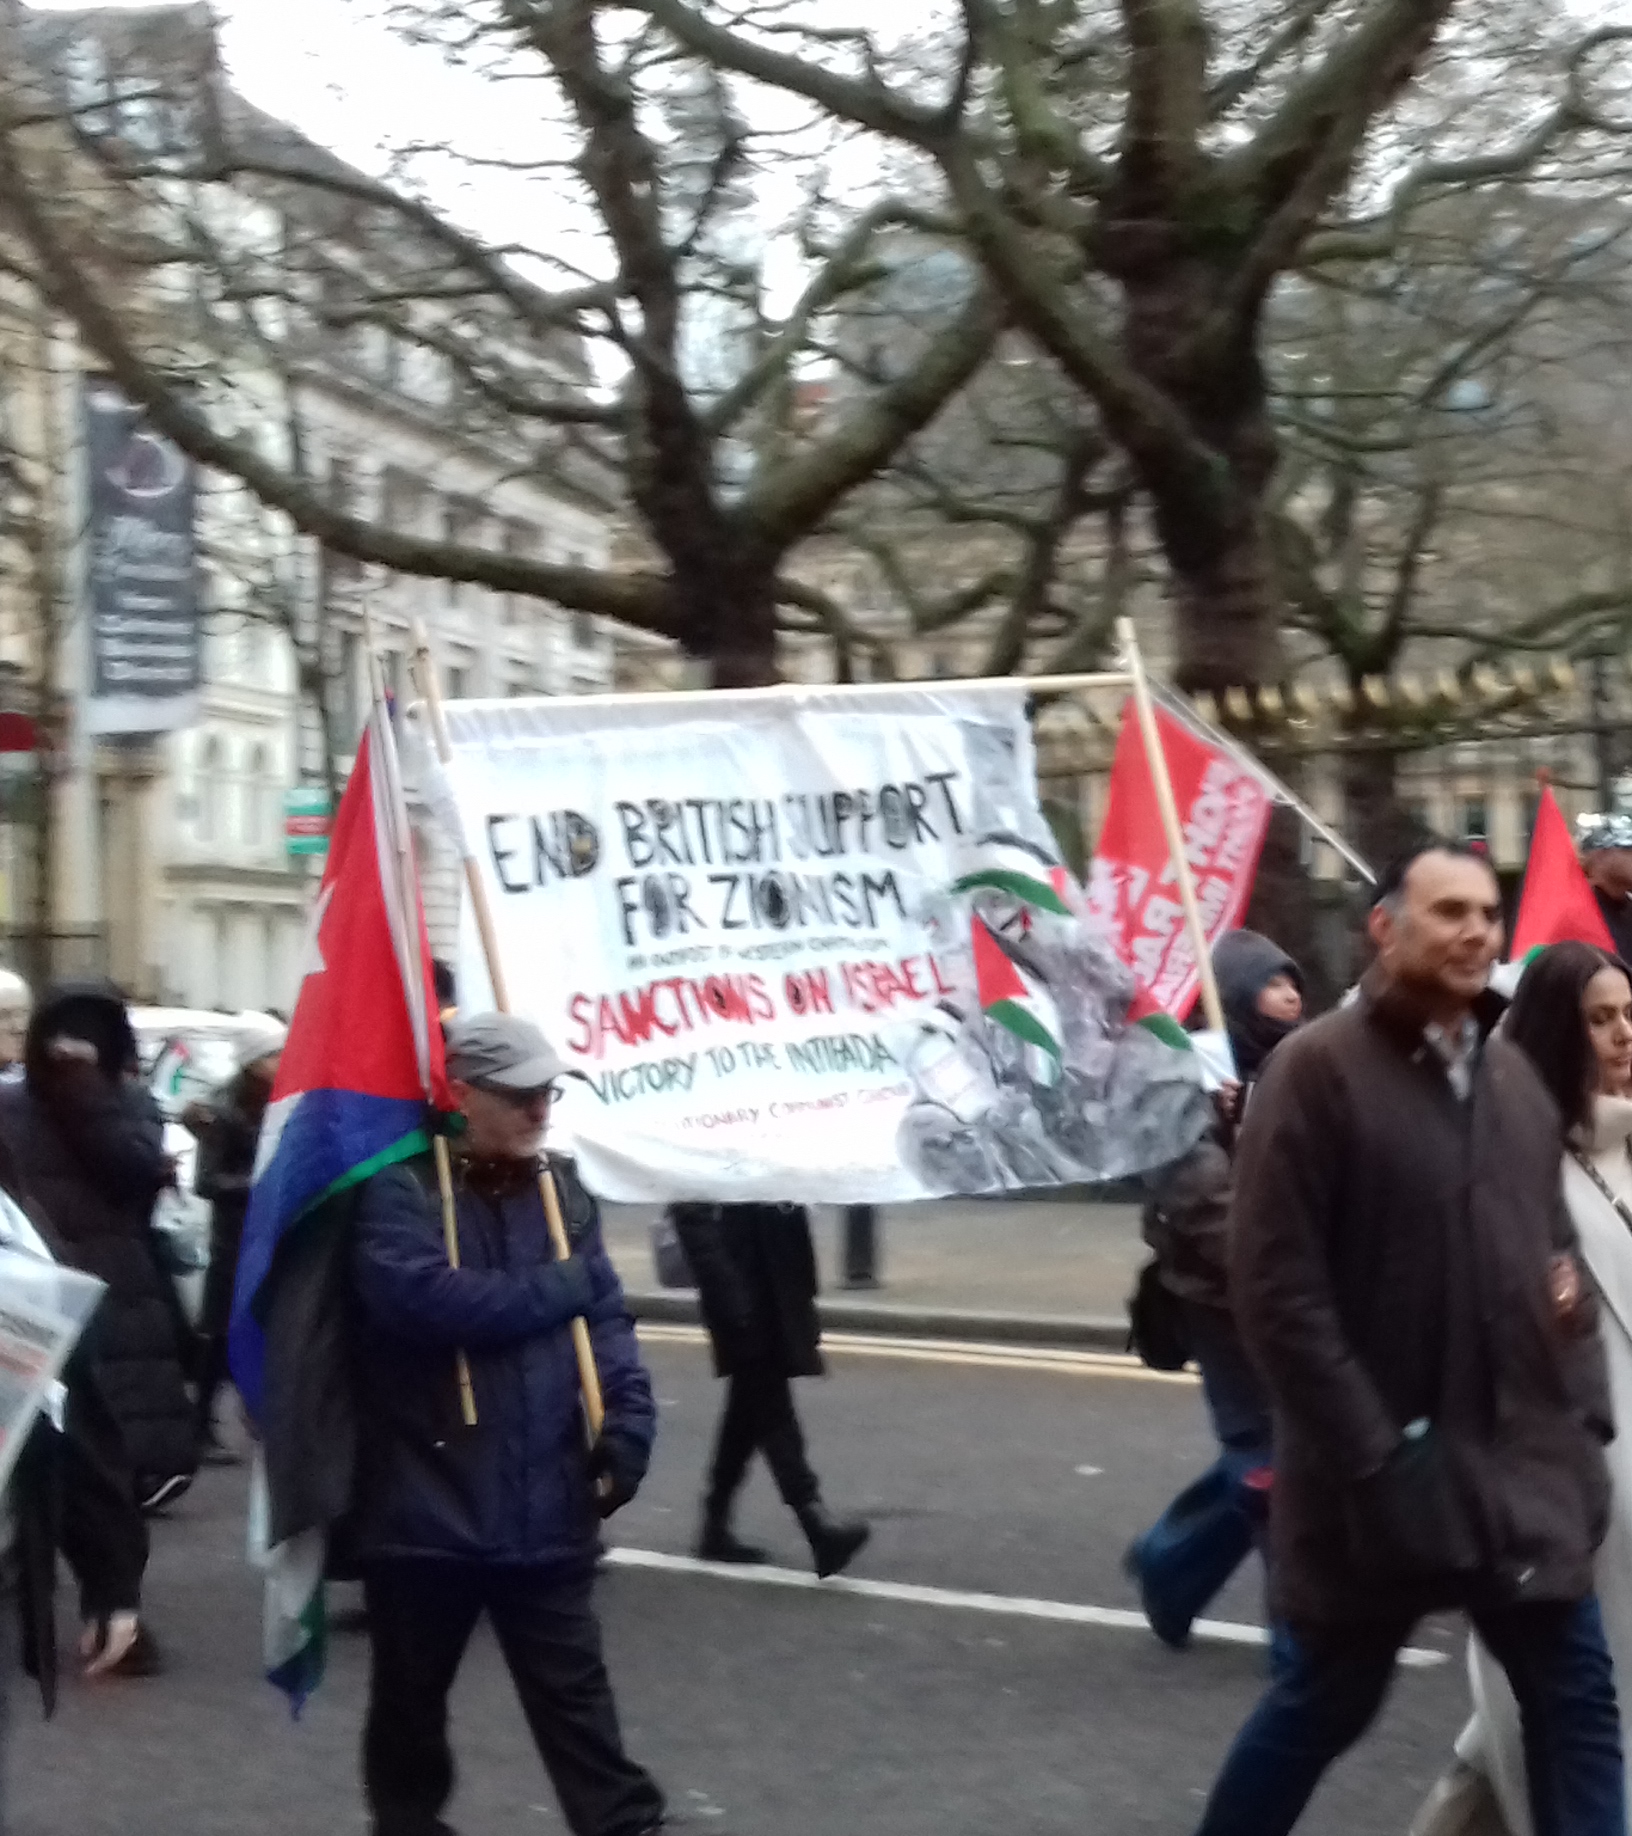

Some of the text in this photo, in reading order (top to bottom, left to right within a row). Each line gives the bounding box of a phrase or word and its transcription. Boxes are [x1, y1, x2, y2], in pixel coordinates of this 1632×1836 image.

[485, 771, 964, 894] END BRITISH SUPPORT
[615, 868, 907, 946] FOR ZIONISM
[566, 951, 958, 1058] SANCTIONS ON ISRAEL
[587, 1032, 900, 1105] VICTORY TO THE INTIFADA
